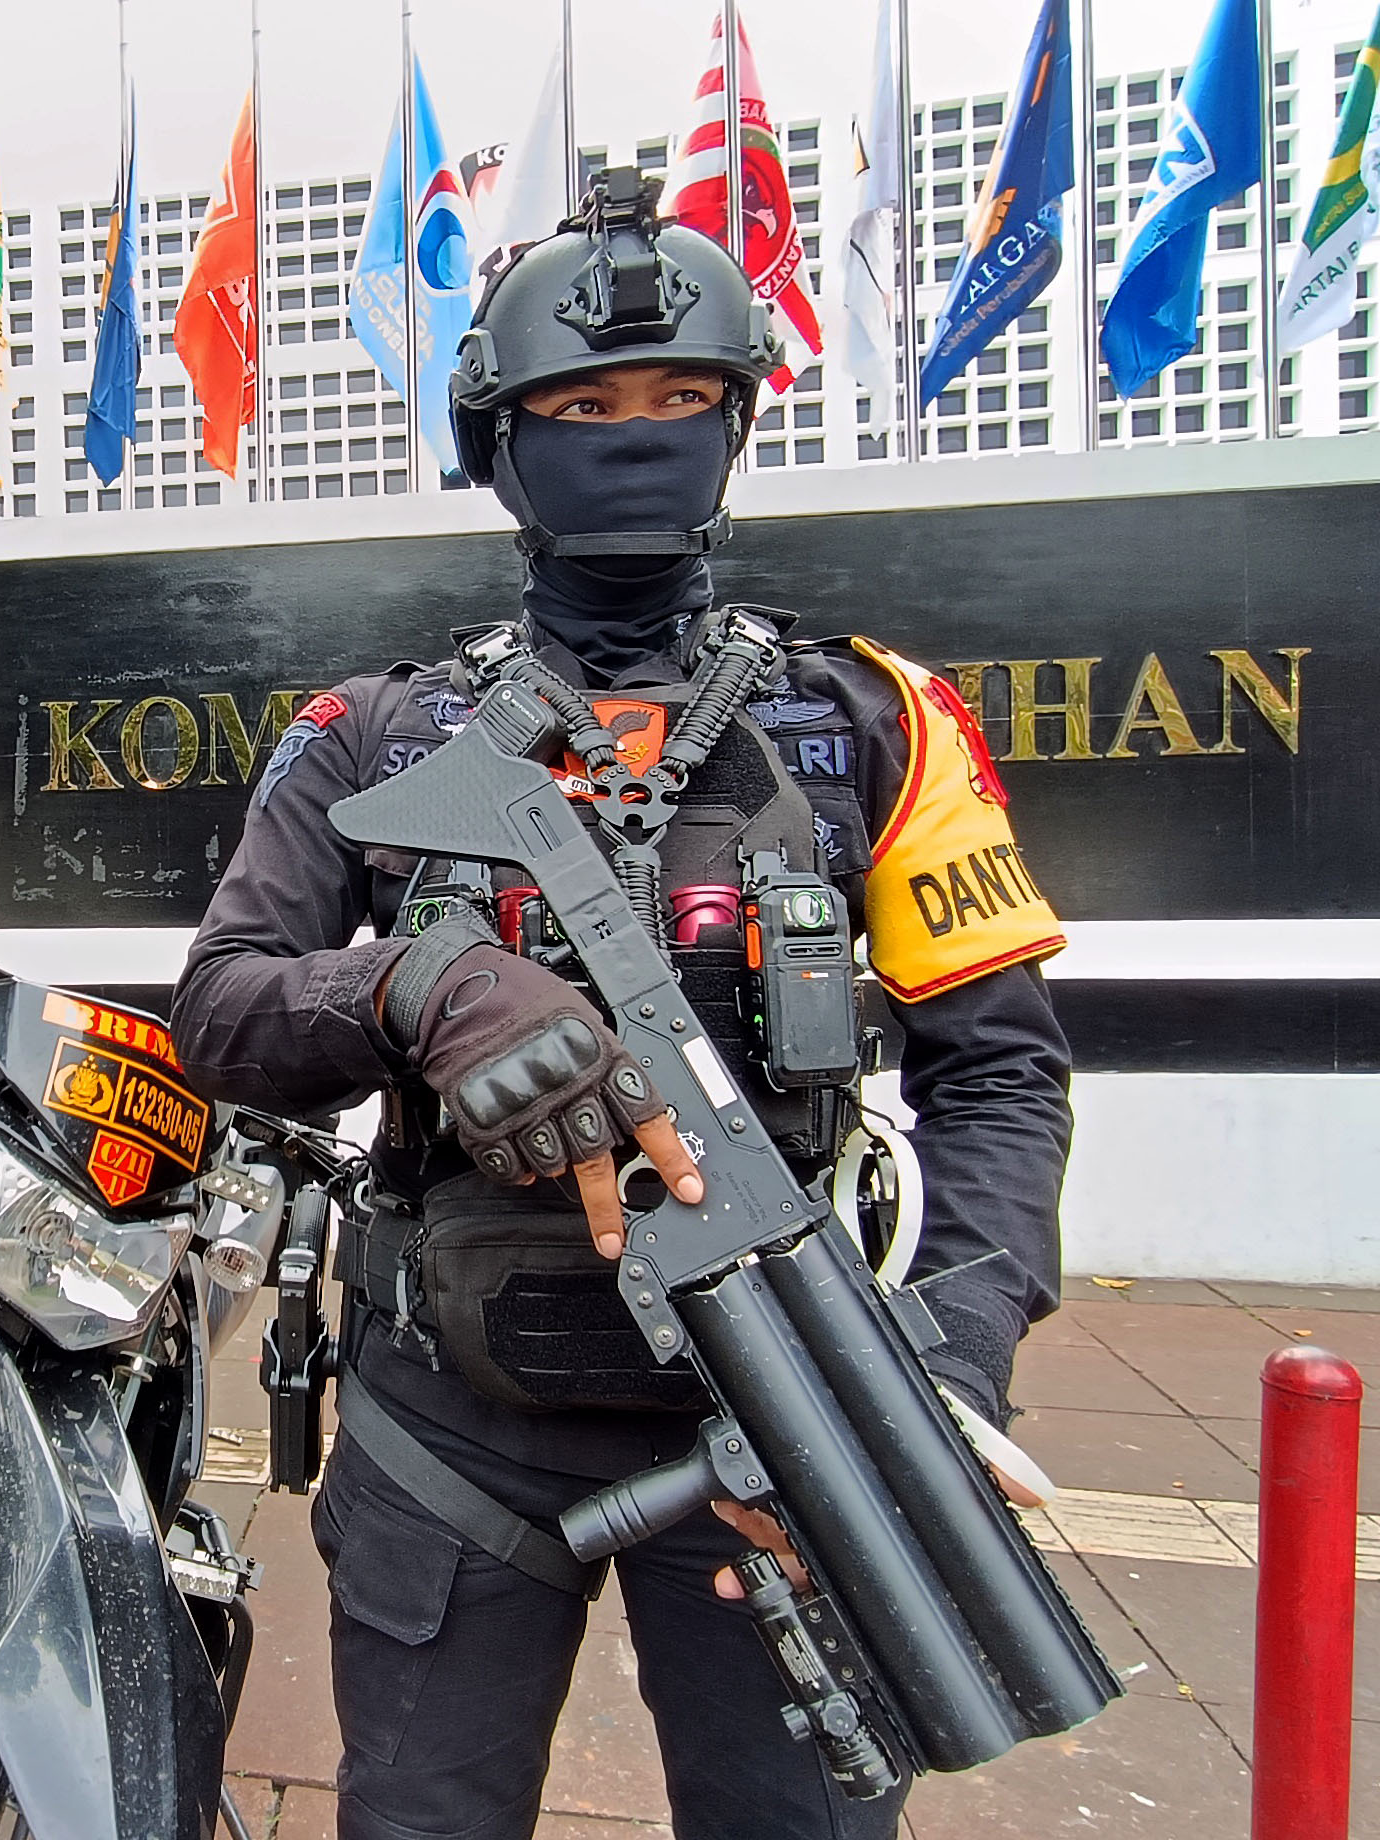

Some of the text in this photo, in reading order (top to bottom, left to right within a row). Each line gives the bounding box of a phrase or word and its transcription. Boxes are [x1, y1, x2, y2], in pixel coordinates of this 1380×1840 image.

[40, 690, 310, 792] KOM
[63, 1001, 180, 1067] BRIM
[123, 1076, 201, 1154] 132330-05
